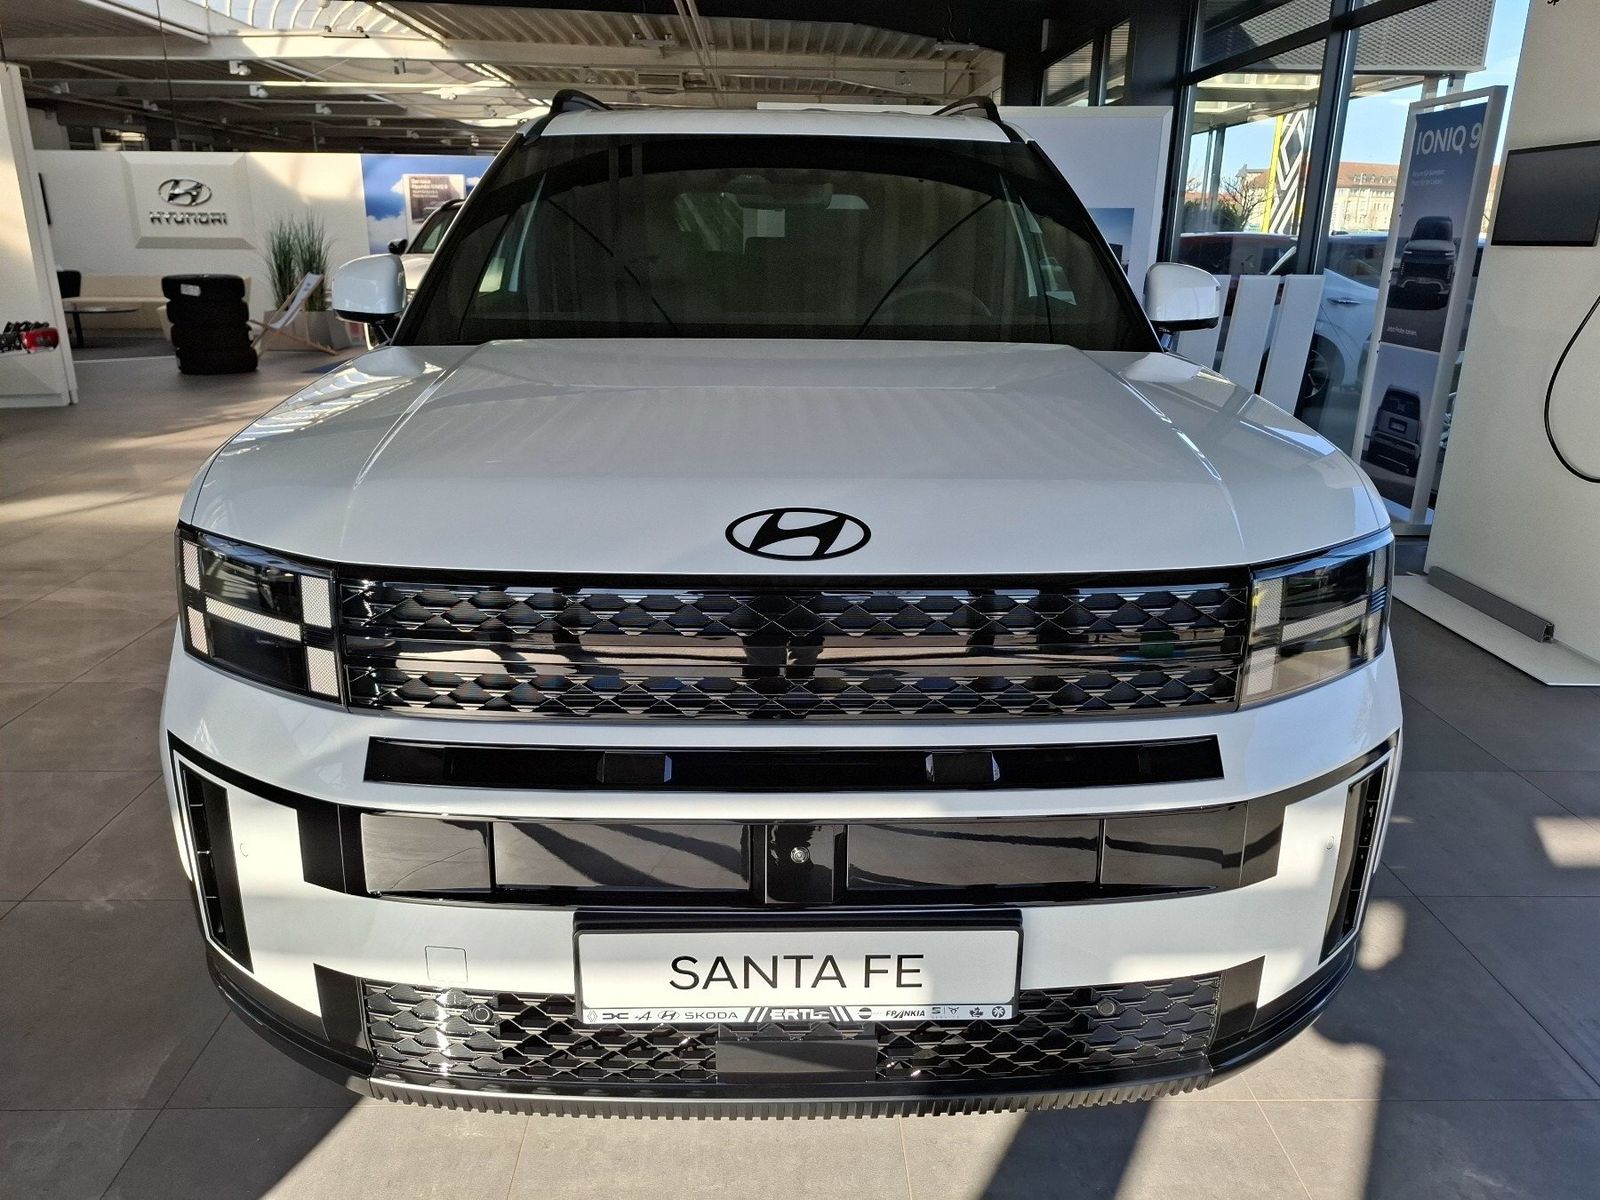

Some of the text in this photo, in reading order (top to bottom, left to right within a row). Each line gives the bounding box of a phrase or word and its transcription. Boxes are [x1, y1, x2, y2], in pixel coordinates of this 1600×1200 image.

[1415, 122, 1482, 155] IONIQ 9
[149, 211, 228, 225] HYUNDAI
[669, 954, 924, 990] SANTA FE
